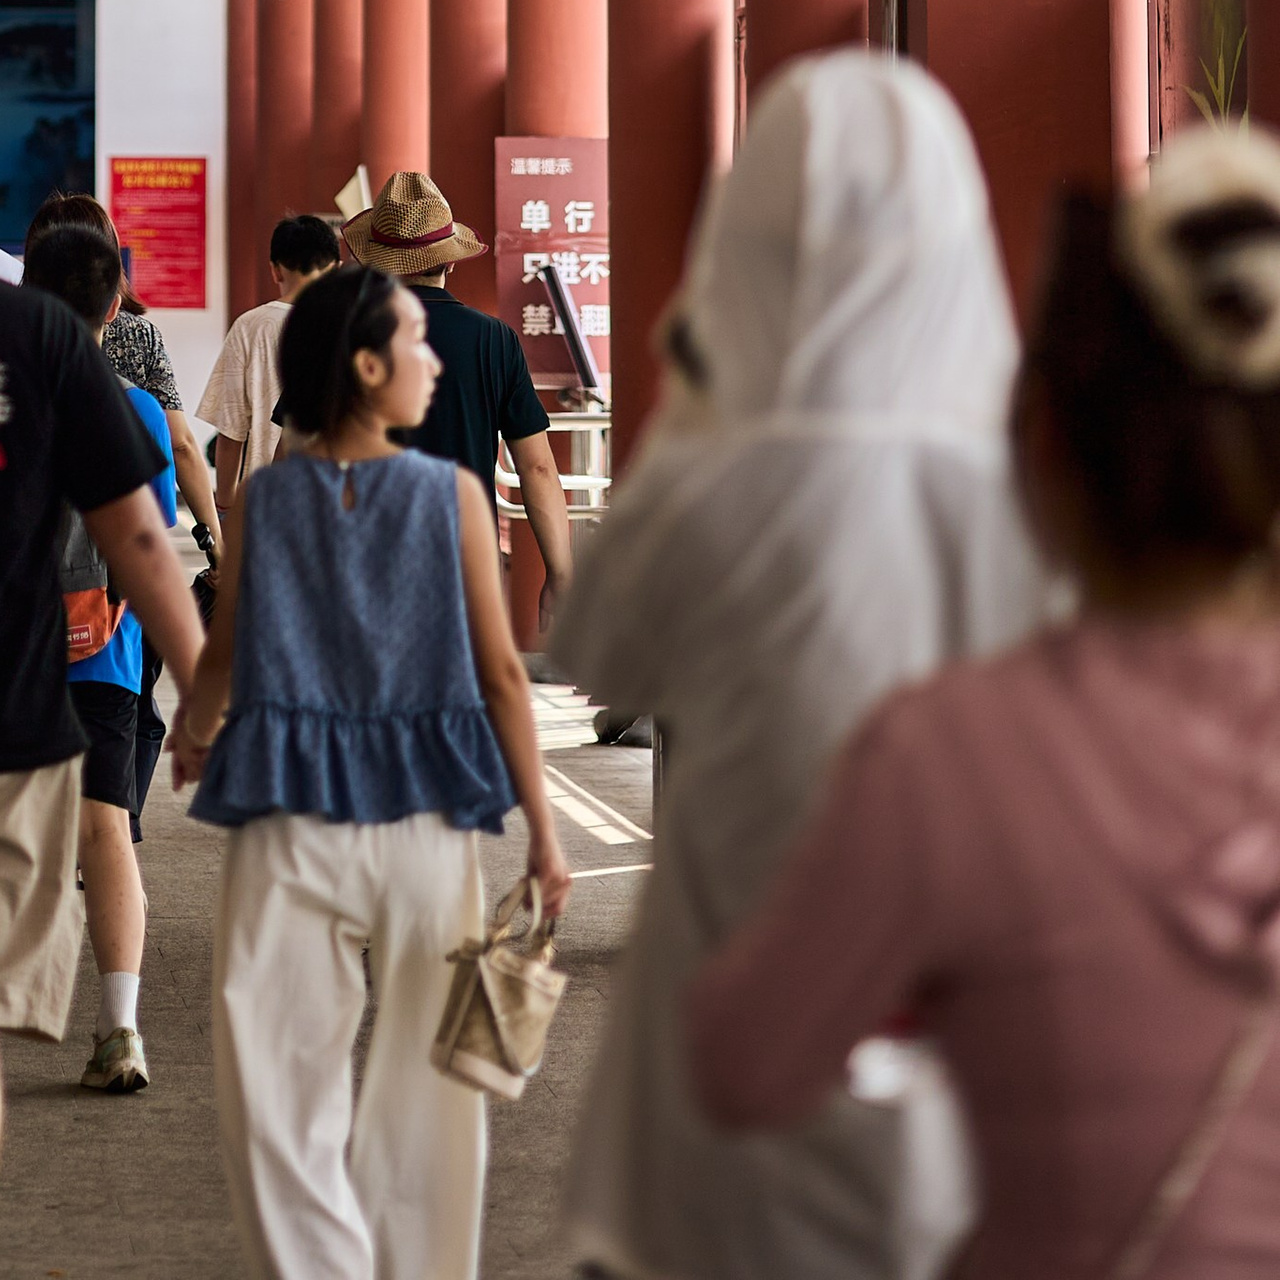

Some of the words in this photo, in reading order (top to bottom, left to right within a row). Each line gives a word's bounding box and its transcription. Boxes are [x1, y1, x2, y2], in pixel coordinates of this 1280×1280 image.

[511, 158, 572, 175] 温馨提示
[521, 200, 595, 233] 单行
[522, 252, 610, 285] 只进不
